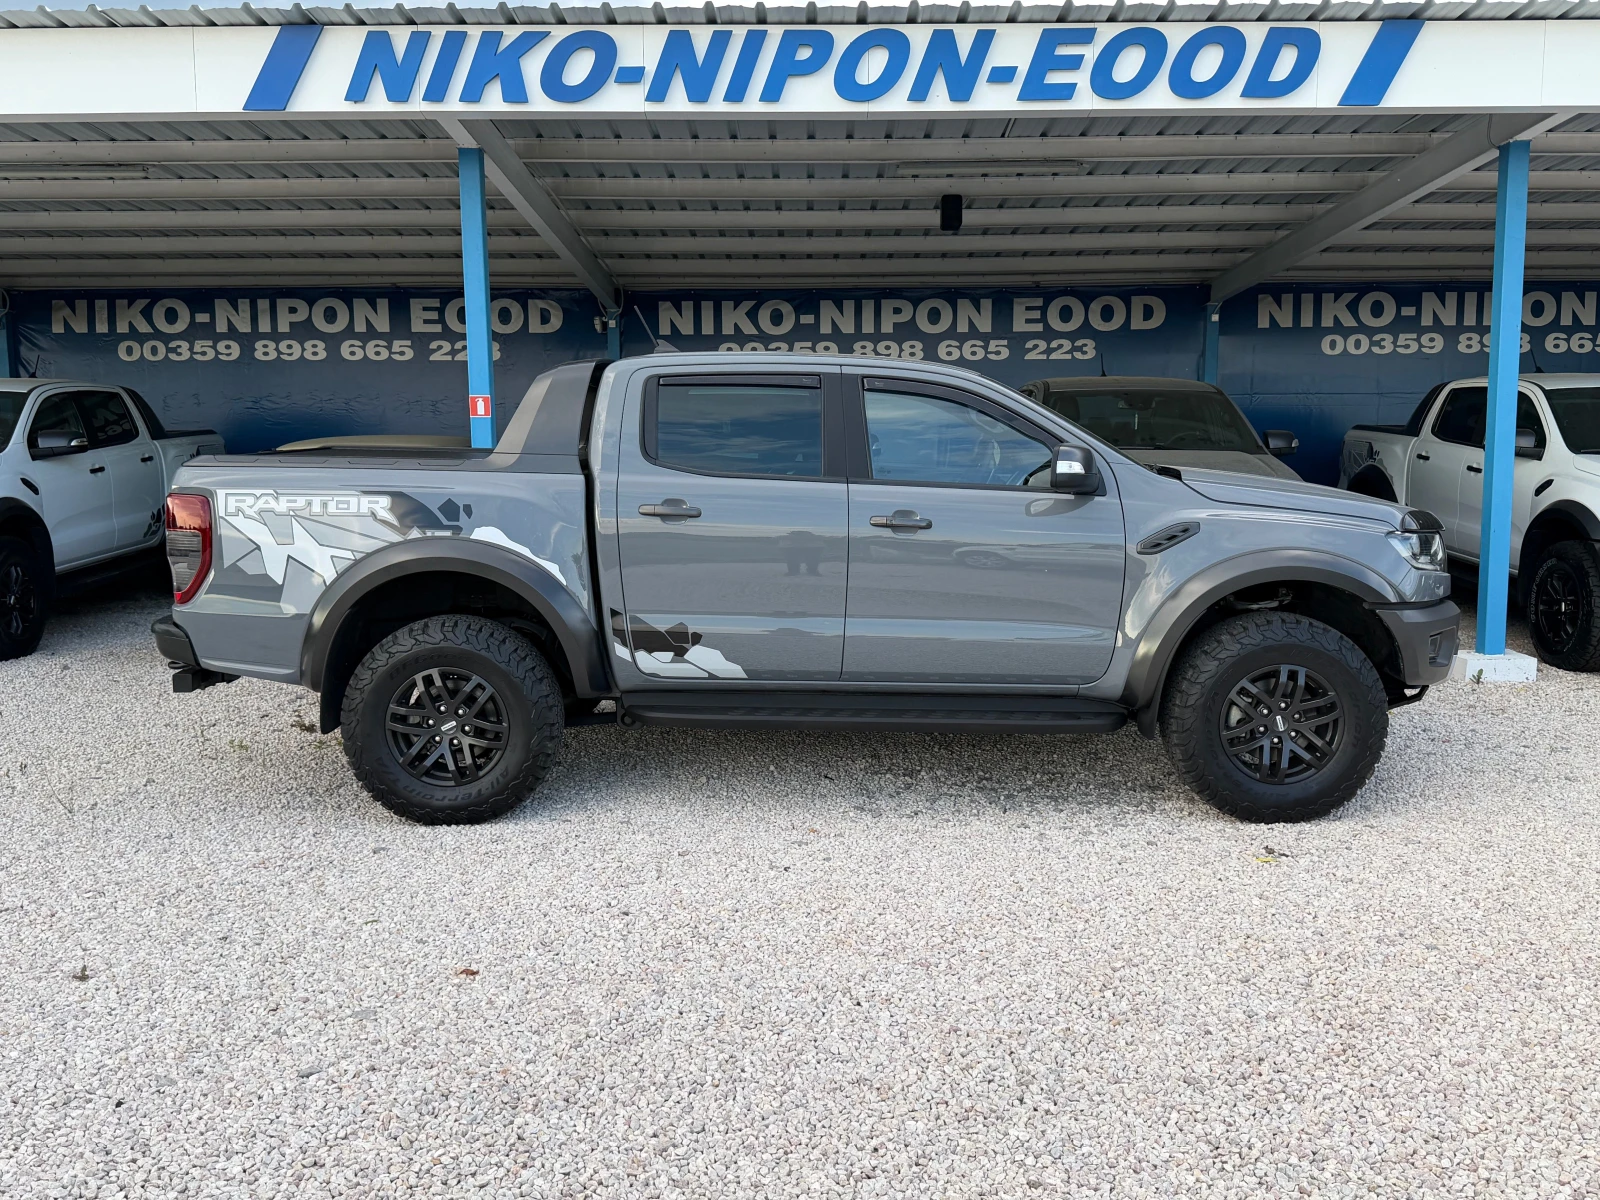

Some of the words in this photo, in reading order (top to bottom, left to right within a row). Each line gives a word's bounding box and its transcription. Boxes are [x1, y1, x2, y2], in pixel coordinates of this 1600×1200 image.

[344, 25, 1322, 104] NIKO-NIPON-EOOD
[51, 298, 391, 334] NIKO-NIPON
[410, 298, 564, 334] EOOD
[657, 298, 993, 335] NIKO-NIPON
[1012, 296, 1166, 333] EOOD
[1257, 291, 1597, 328] NIKO-NION
[117, 340, 241, 362] 00359
[253, 340, 327, 361] 898
[340, 340, 414, 361] 665
[852, 340, 924, 360] 898
[937, 339, 1010, 361] 665
[1024, 338, 1097, 360] 223
[1321, 333, 1444, 355] 00359
[1544, 332, 1600, 354] 66
[225, 493, 400, 527] RAPTOR
